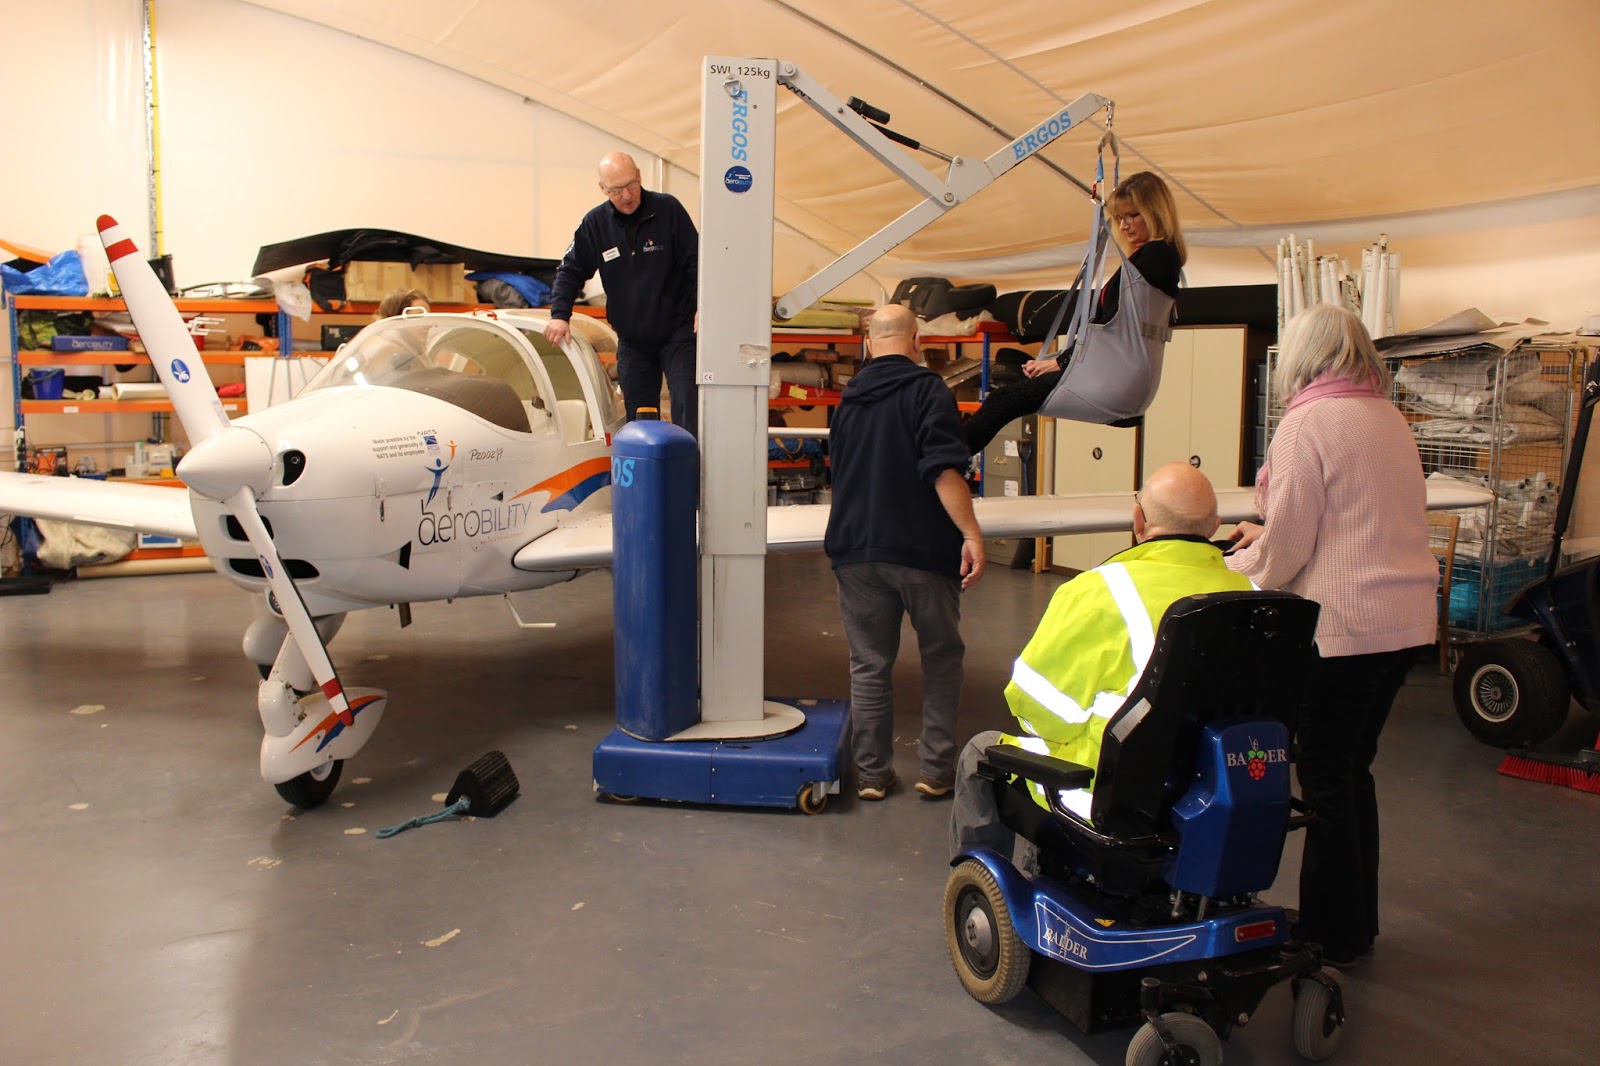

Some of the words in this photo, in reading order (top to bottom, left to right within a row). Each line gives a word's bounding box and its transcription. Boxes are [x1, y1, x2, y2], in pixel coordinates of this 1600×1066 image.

[737, 67, 770, 79] 125kg
[1012, 112, 1071, 160] ERGOS
[1226, 749, 1288, 767] BAER
